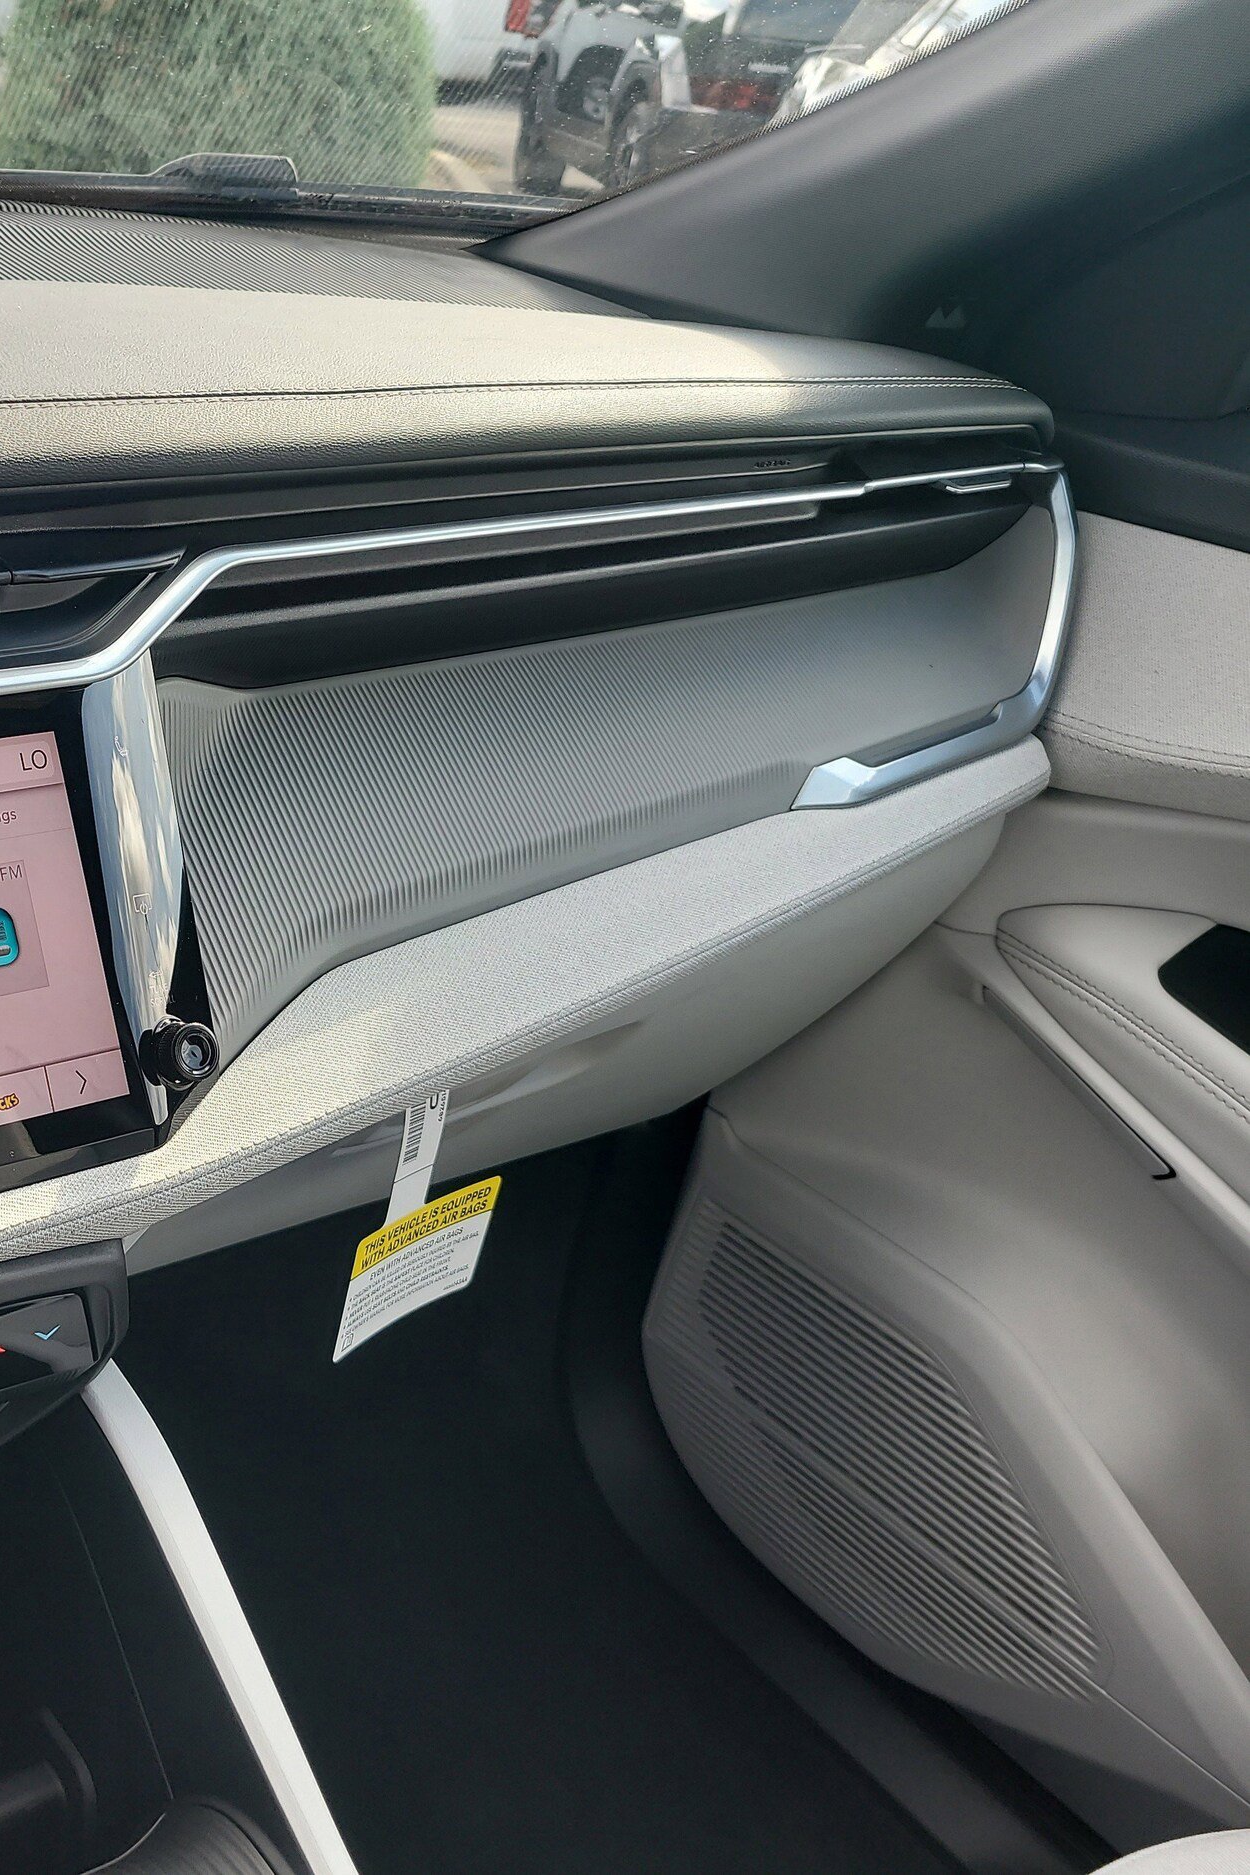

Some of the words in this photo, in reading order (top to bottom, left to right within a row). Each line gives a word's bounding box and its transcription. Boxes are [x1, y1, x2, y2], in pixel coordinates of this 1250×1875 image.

[18, 749, 48, 773] LO
[0, 864, 24, 882] FM
[361, 1248, 388, 1270] WITH
[386, 1221, 440, 1252] ADVANCED
[440, 1211, 459, 1227] AIR
[459, 1200, 488, 1218] BAGS
[364, 1233, 386, 1255] THIS
[387, 1210, 429, 1238] VEHICLE
[429, 1207, 439, 1220] IS
[440, 1186, 491, 1214] EQUIPPED
